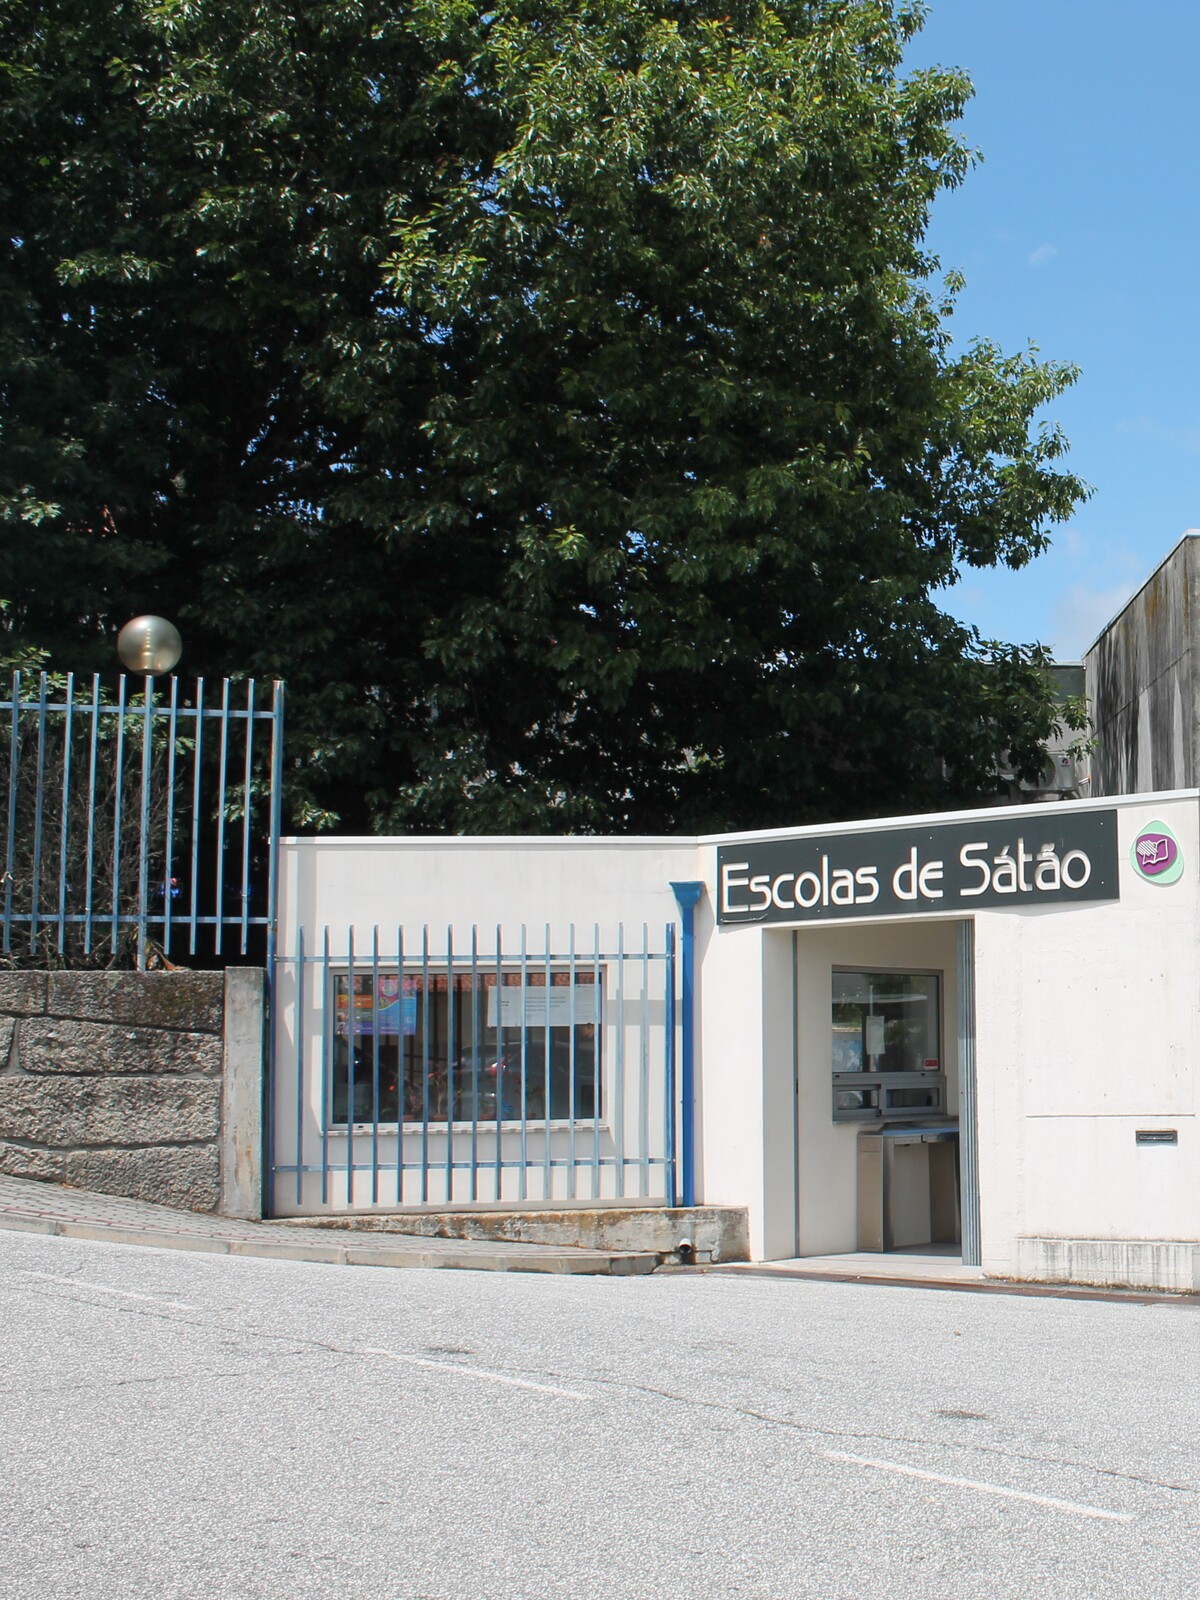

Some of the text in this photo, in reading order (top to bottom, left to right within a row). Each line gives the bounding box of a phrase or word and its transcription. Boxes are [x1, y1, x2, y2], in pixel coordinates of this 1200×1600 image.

[722, 837, 1091, 913] Escolas de Sátão
